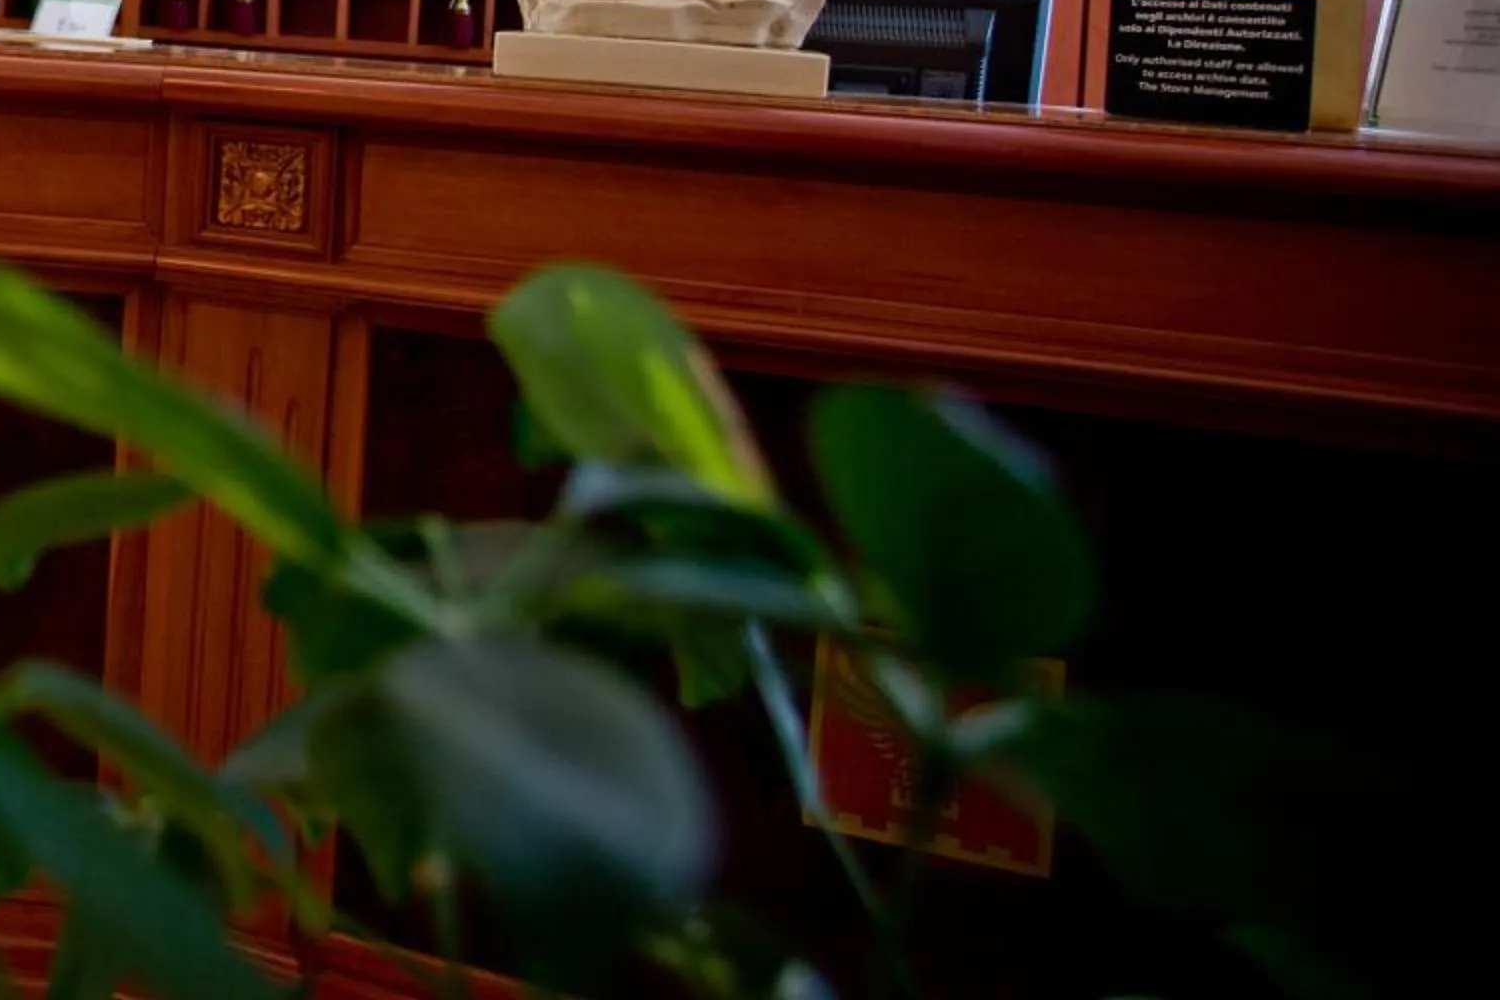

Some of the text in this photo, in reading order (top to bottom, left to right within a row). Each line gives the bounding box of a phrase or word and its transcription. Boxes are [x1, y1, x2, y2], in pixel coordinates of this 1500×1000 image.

[1201, 0, 1228, 10] Dati
[1229, 1, 1293, 13] contenuti
[1135, 11, 1164, 23] negli
[1165, 12, 1205, 22] archivi
[1217, 15, 1287, 26] consentito
[1118, 24, 1303, 40] solo ai Dipendenti Autorizzati.
[1167, 39, 1182, 49] La
[1115, 53, 1140, 66] Only
[1203, 58, 1233, 69] staff
[1234, 63, 1254, 71] are
[1256, 62, 1304, 74] allowed
[1141, 69, 1155, 78] to
[1157, 71, 1193, 81] access
[1195, 72, 1237, 83] archive
[1139, 81, 1158, 91] The
[1160, 82, 1191, 93] Store
